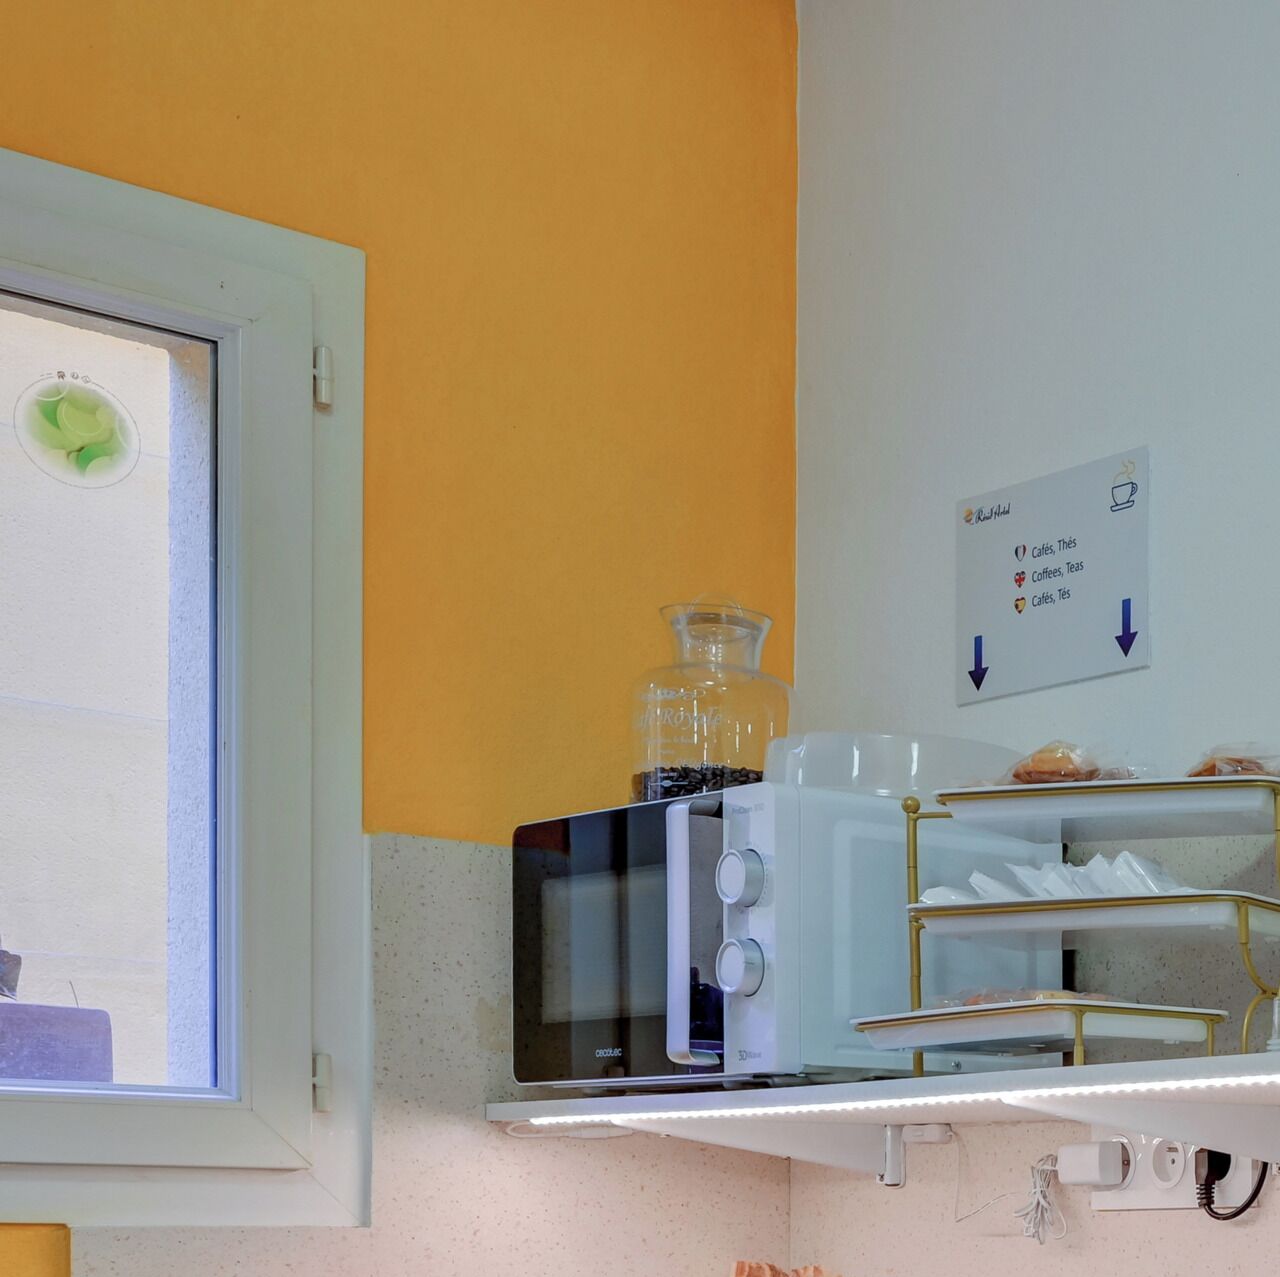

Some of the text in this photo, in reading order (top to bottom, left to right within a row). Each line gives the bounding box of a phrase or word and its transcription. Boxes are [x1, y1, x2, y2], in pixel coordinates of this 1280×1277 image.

[1032, 536, 1077, 559] Cafés, Thés
[1032, 559, 1084, 583] Coffees, Teas
[1032, 587, 1071, 608] Cafés, Tés
